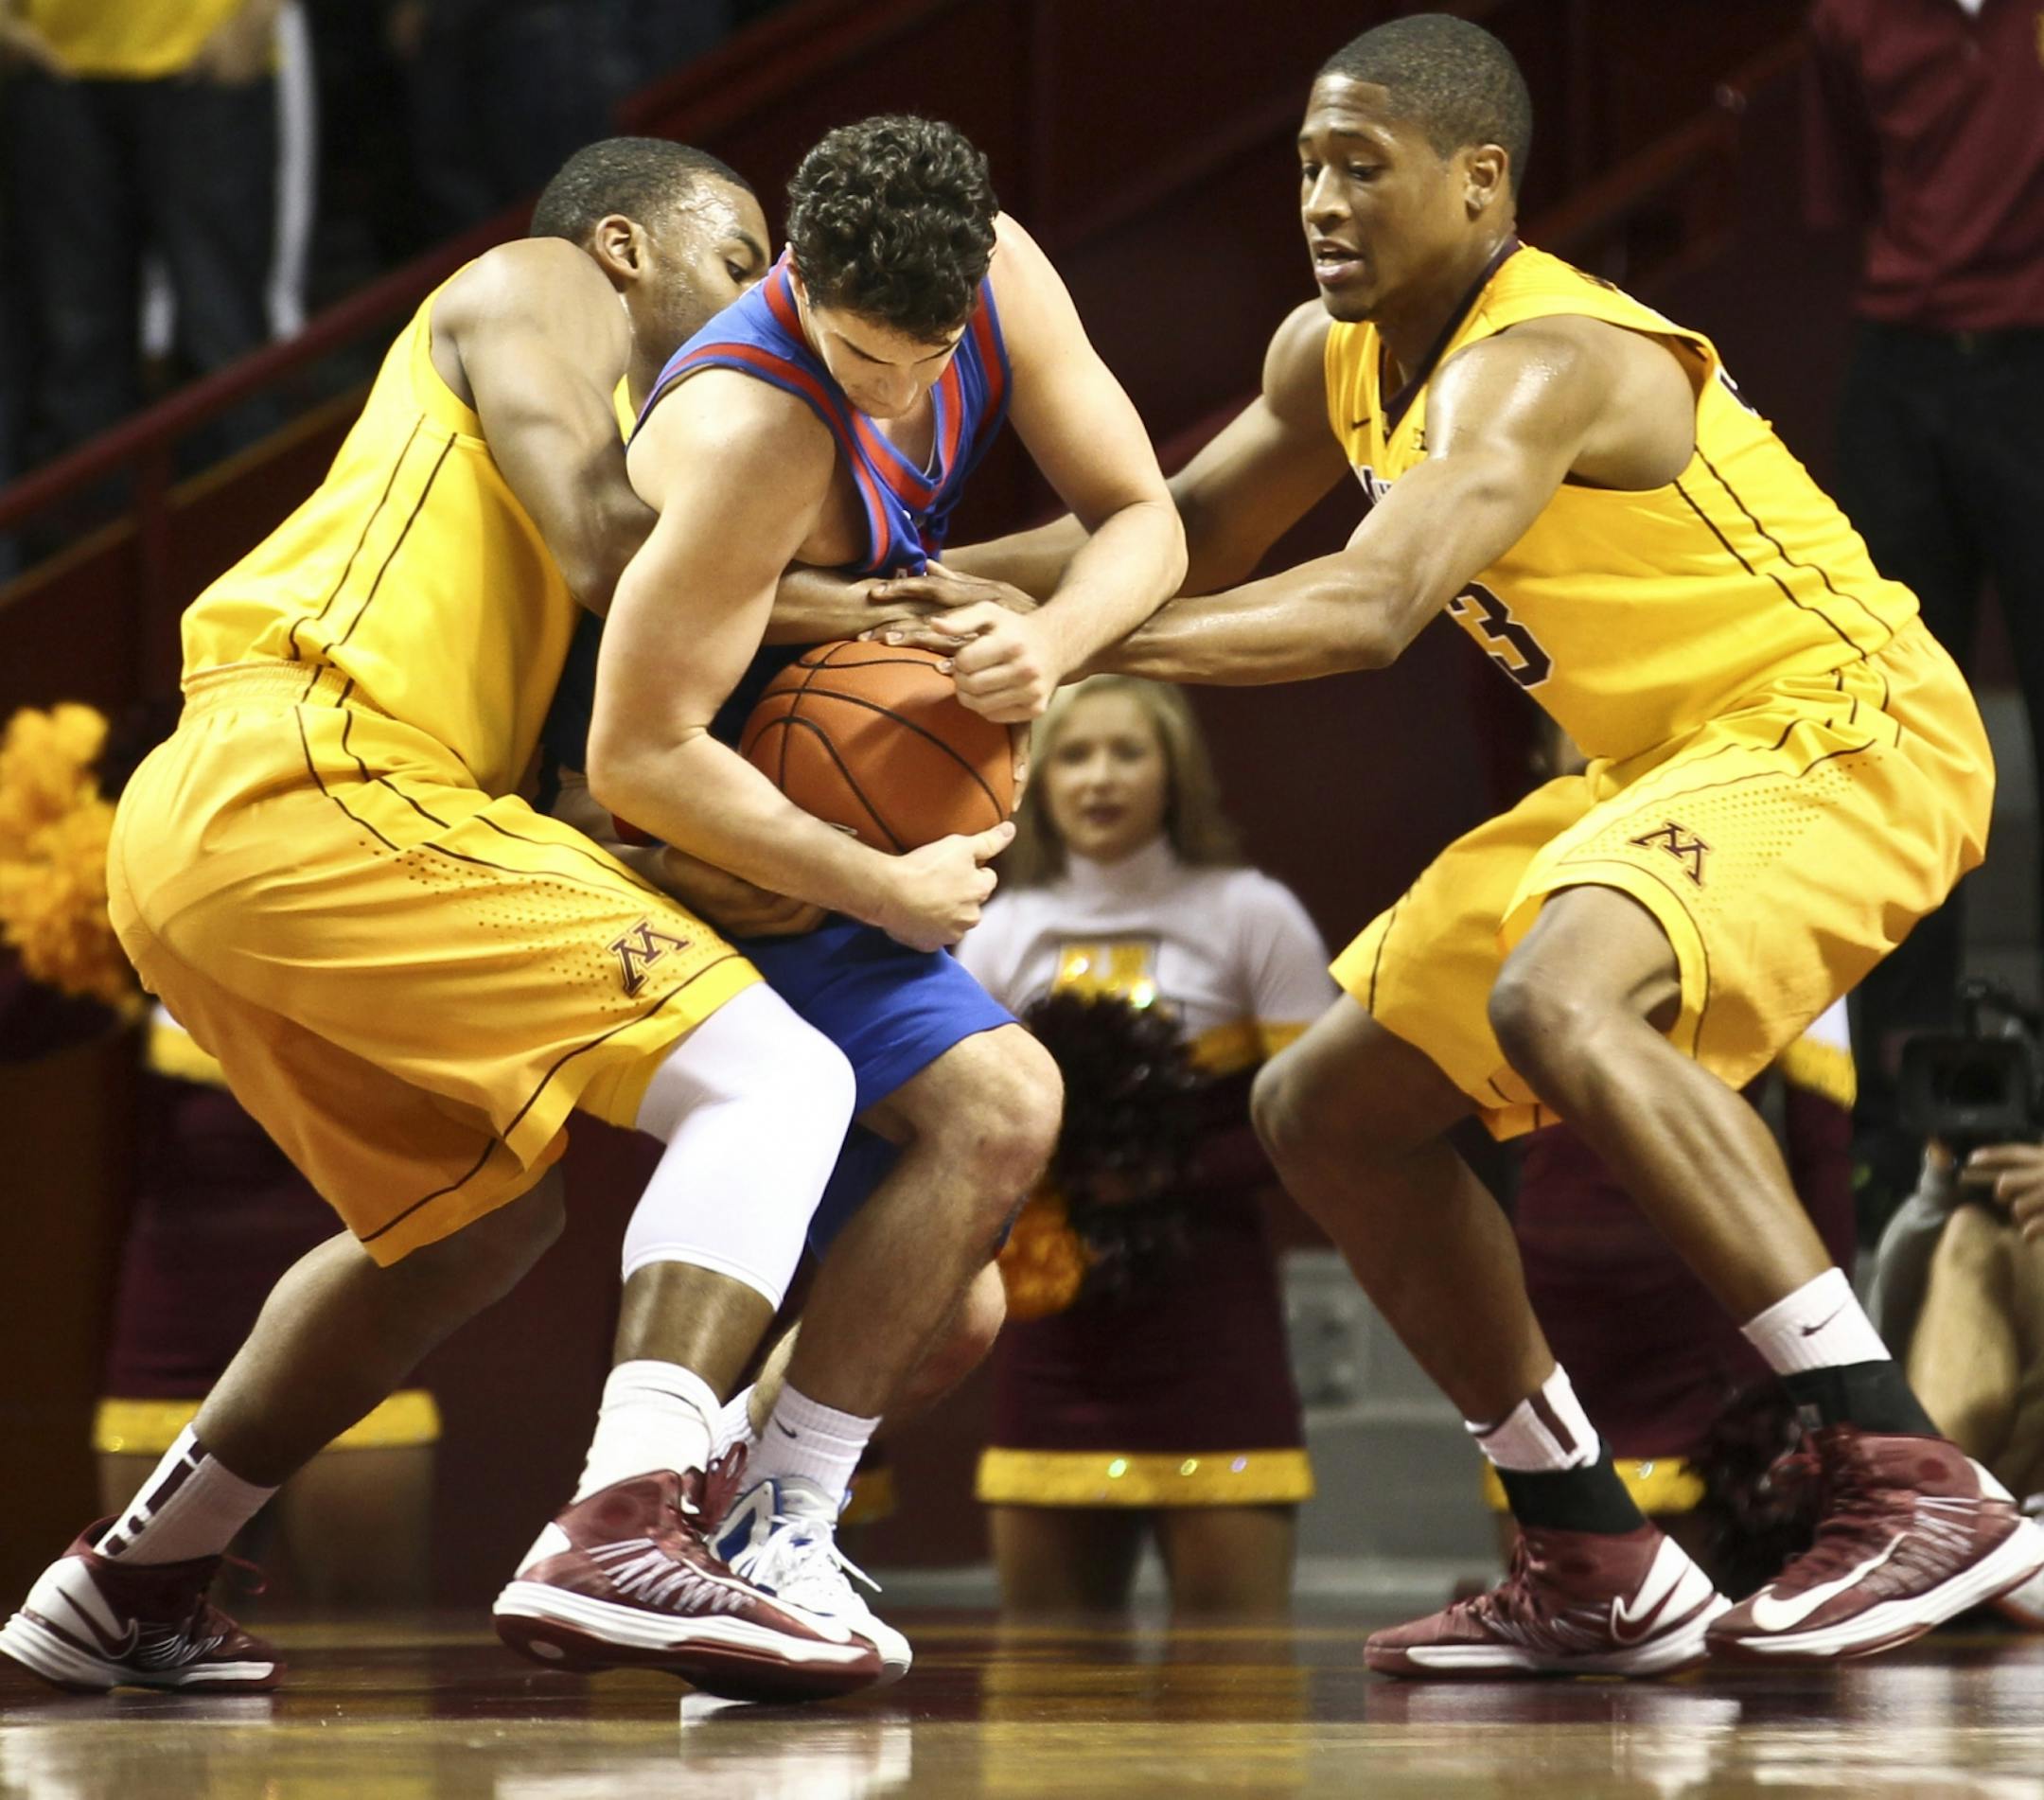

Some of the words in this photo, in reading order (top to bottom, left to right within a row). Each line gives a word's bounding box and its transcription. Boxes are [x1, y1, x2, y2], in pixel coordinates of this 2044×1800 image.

[1444, 580, 1553, 690] 3
[1627, 820, 1712, 890] M
[608, 917, 693, 998] M
